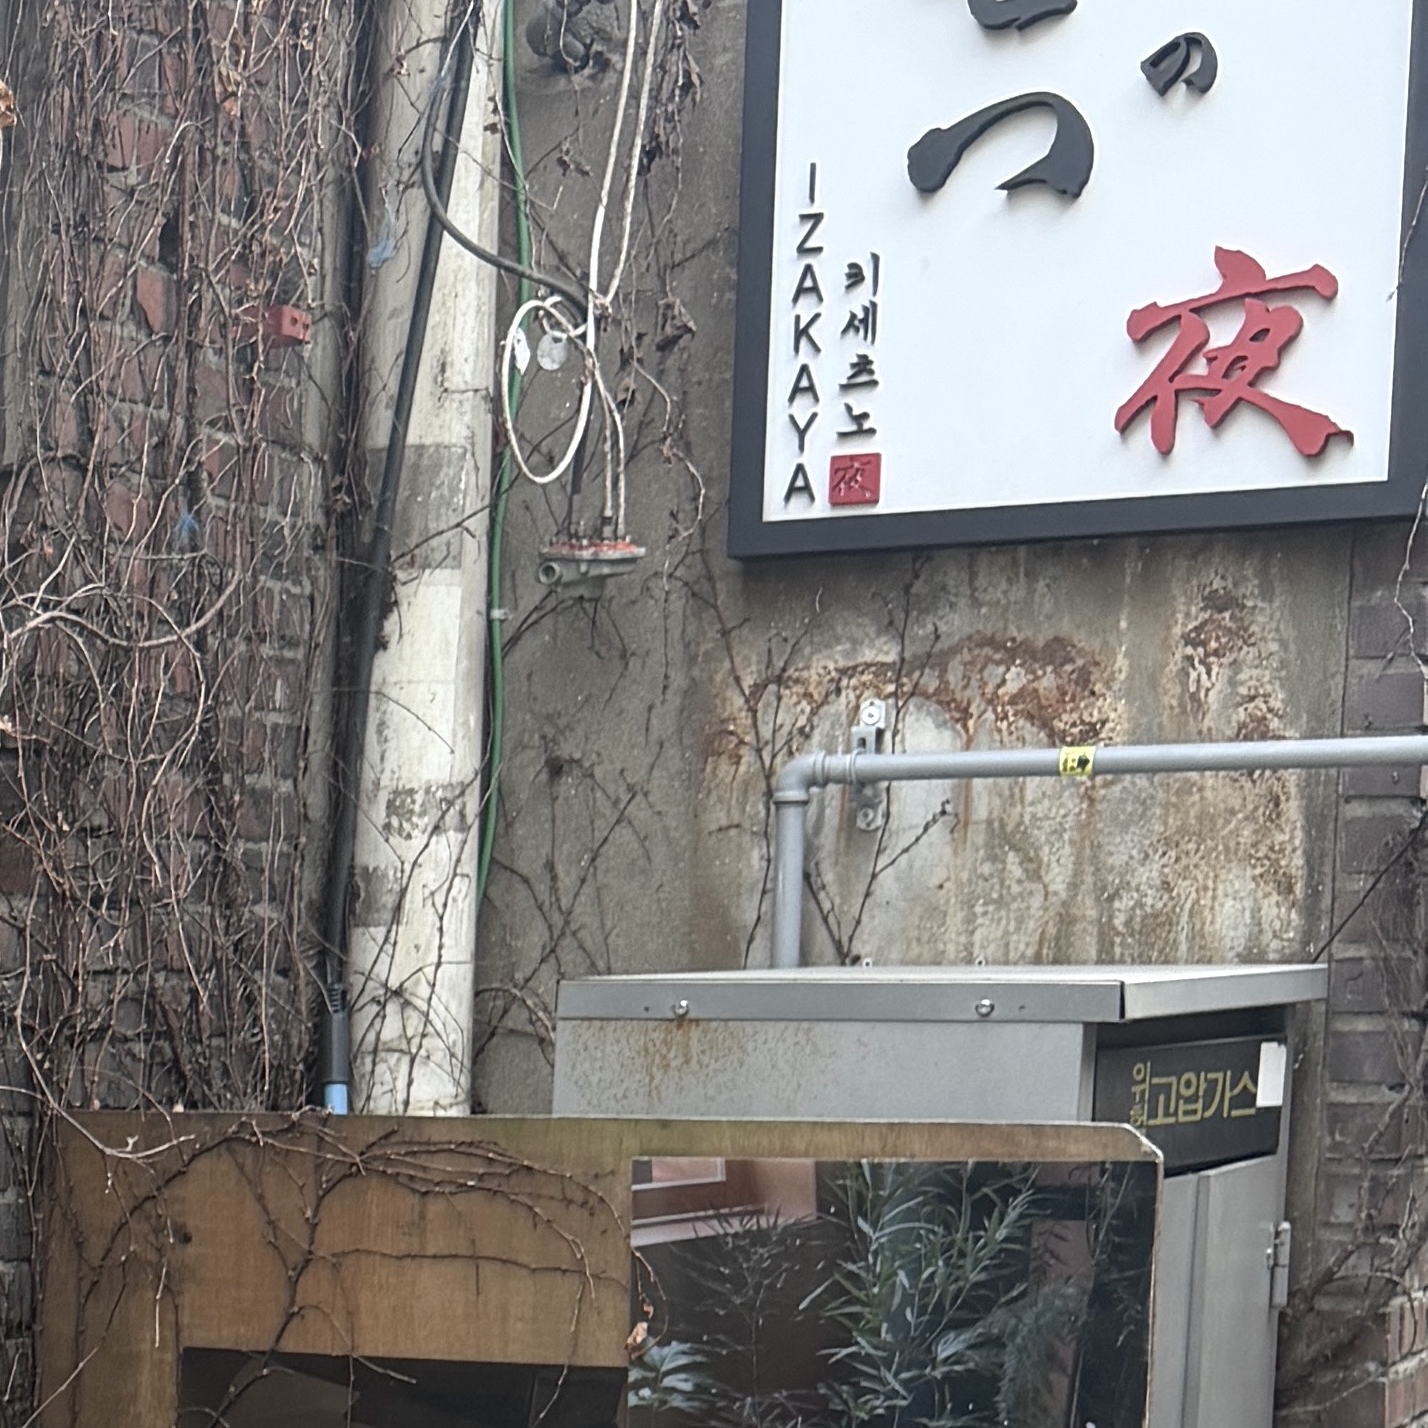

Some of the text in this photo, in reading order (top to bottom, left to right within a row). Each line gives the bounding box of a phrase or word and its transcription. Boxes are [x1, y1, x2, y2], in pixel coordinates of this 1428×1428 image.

[784, 162, 825, 505] IZAKAYA
[836, 251, 881, 438] 키세츠노
[1115, 246, 1354, 457] 夜
[1147, 1069, 1257, 1128] 고압가스
